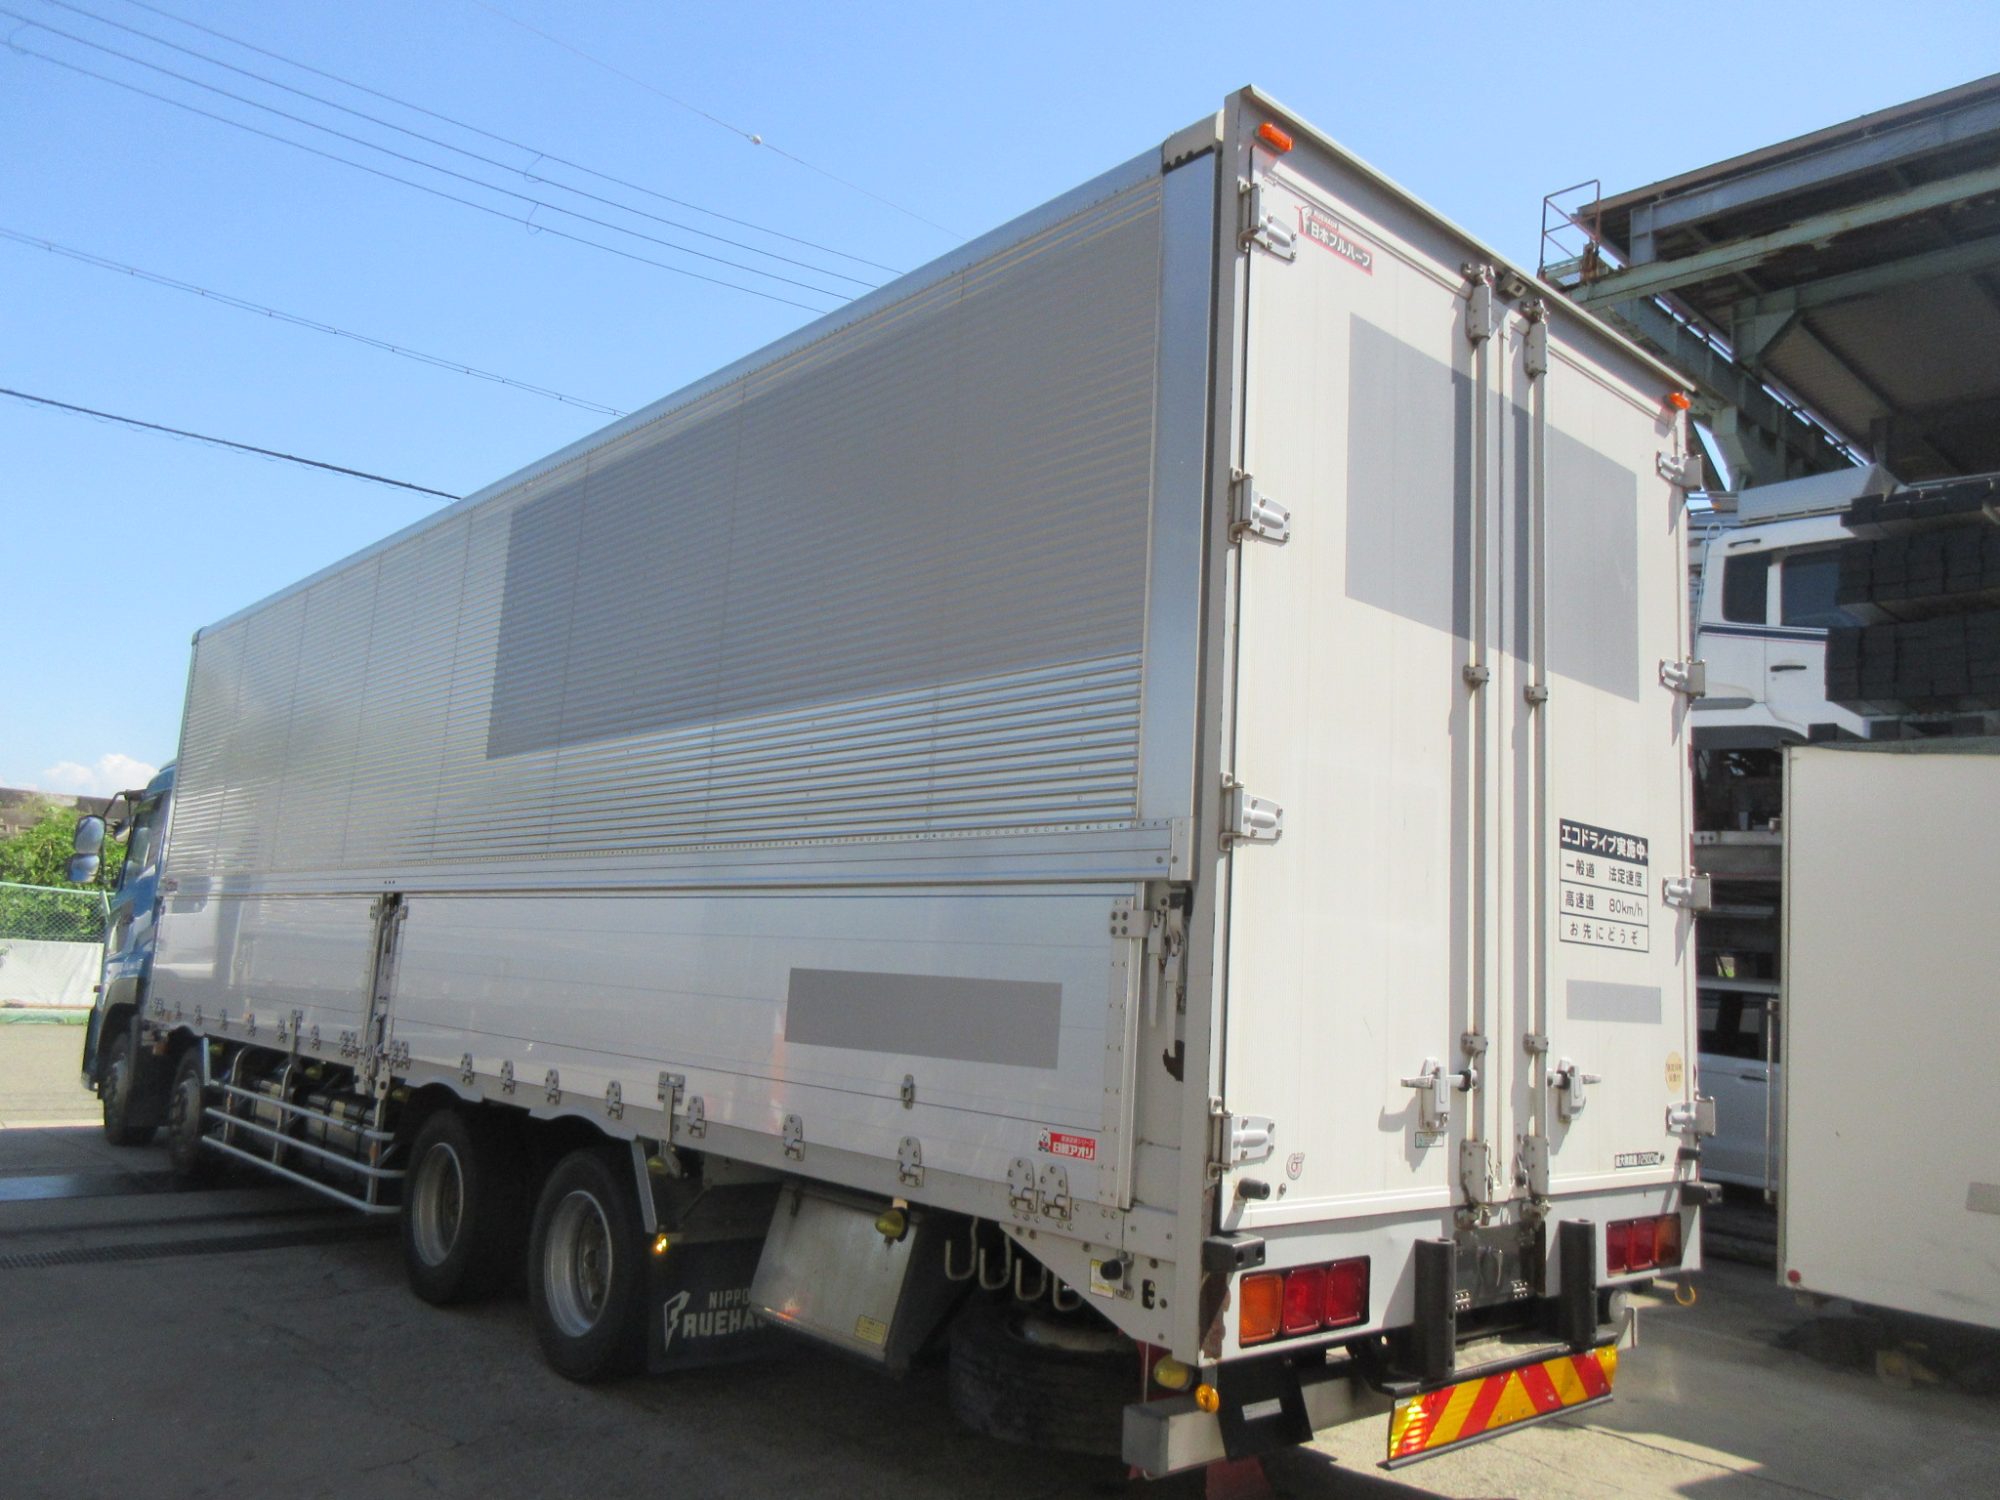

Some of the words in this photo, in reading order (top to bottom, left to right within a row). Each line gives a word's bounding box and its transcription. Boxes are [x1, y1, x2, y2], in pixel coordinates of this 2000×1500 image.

[1311, 221, 1370, 267] 日本フルハーフ
[1561, 825, 1646, 860] エコドライブ実施中
[1565, 859, 1595, 878] 一般道
[1608, 866, 1643, 887] 法定速度
[1565, 890, 1595, 911] 高速道
[1609, 898, 1643, 917] 80km/h
